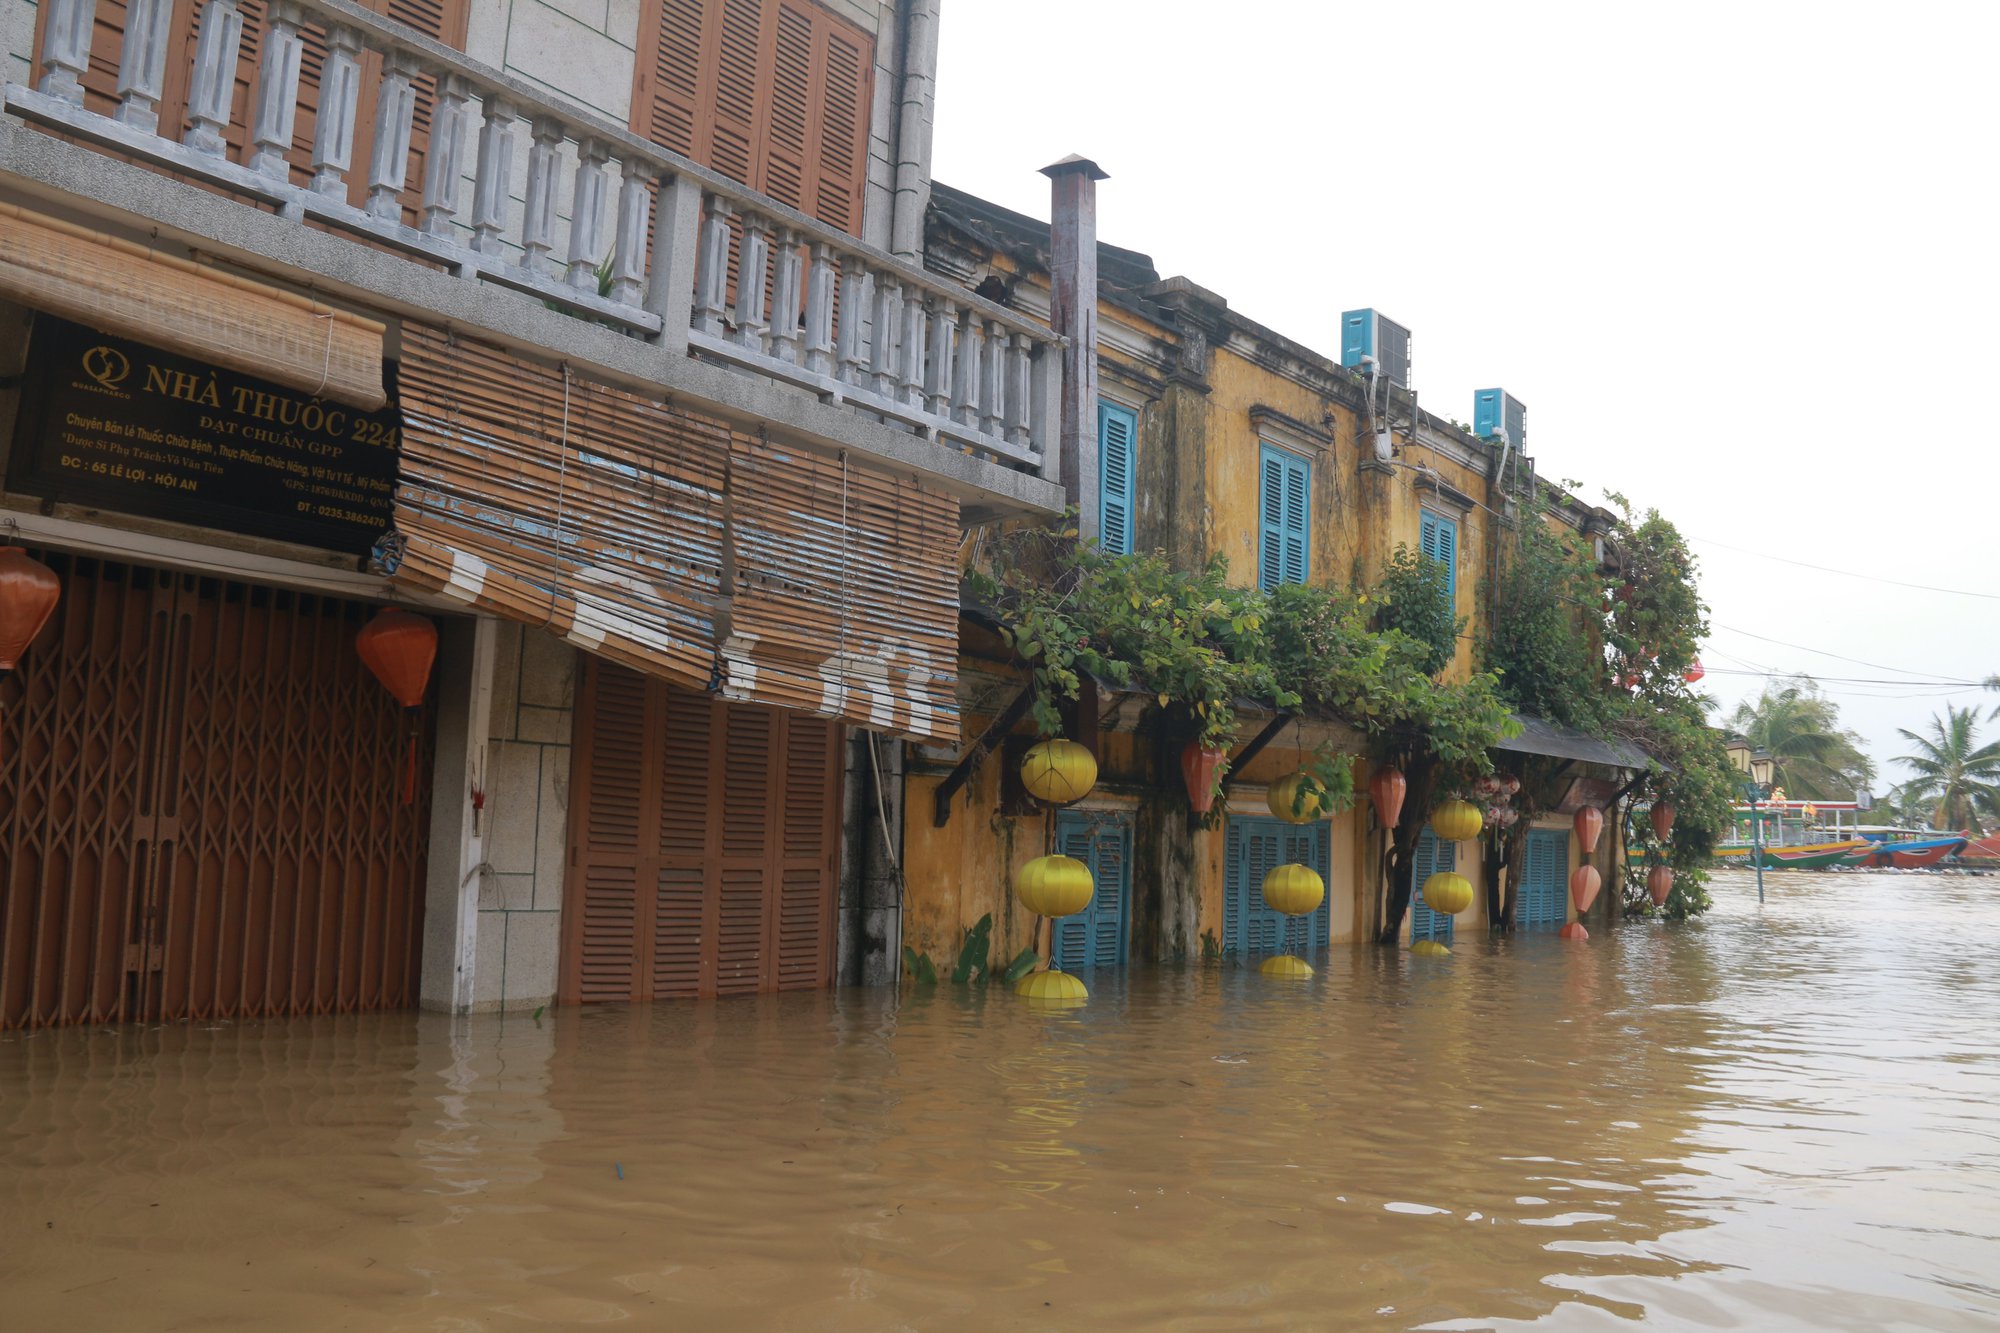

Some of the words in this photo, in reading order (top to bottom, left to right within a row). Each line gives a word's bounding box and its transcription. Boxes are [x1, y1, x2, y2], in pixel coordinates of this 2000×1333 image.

[142, 364, 221, 408] NHÀ
[231, 386, 346, 436] THUỐC
[351, 418, 397, 450] 224
[66, 412, 103, 430] Chuyên
[137, 427, 164, 444] Thuốc
[191, 438, 213, 455] Bệnh
[199, 415, 238, 434] ĐẠT
[241, 425, 305, 450] CHUẨN
[308, 440, 343, 459] GPP
[92, 461, 107, 474] 65
[110, 463, 123, 477] LÊ
[126, 468, 145, 483] LỢI
[155, 473, 177, 489] HỘI
[180, 478, 198, 491] AN
